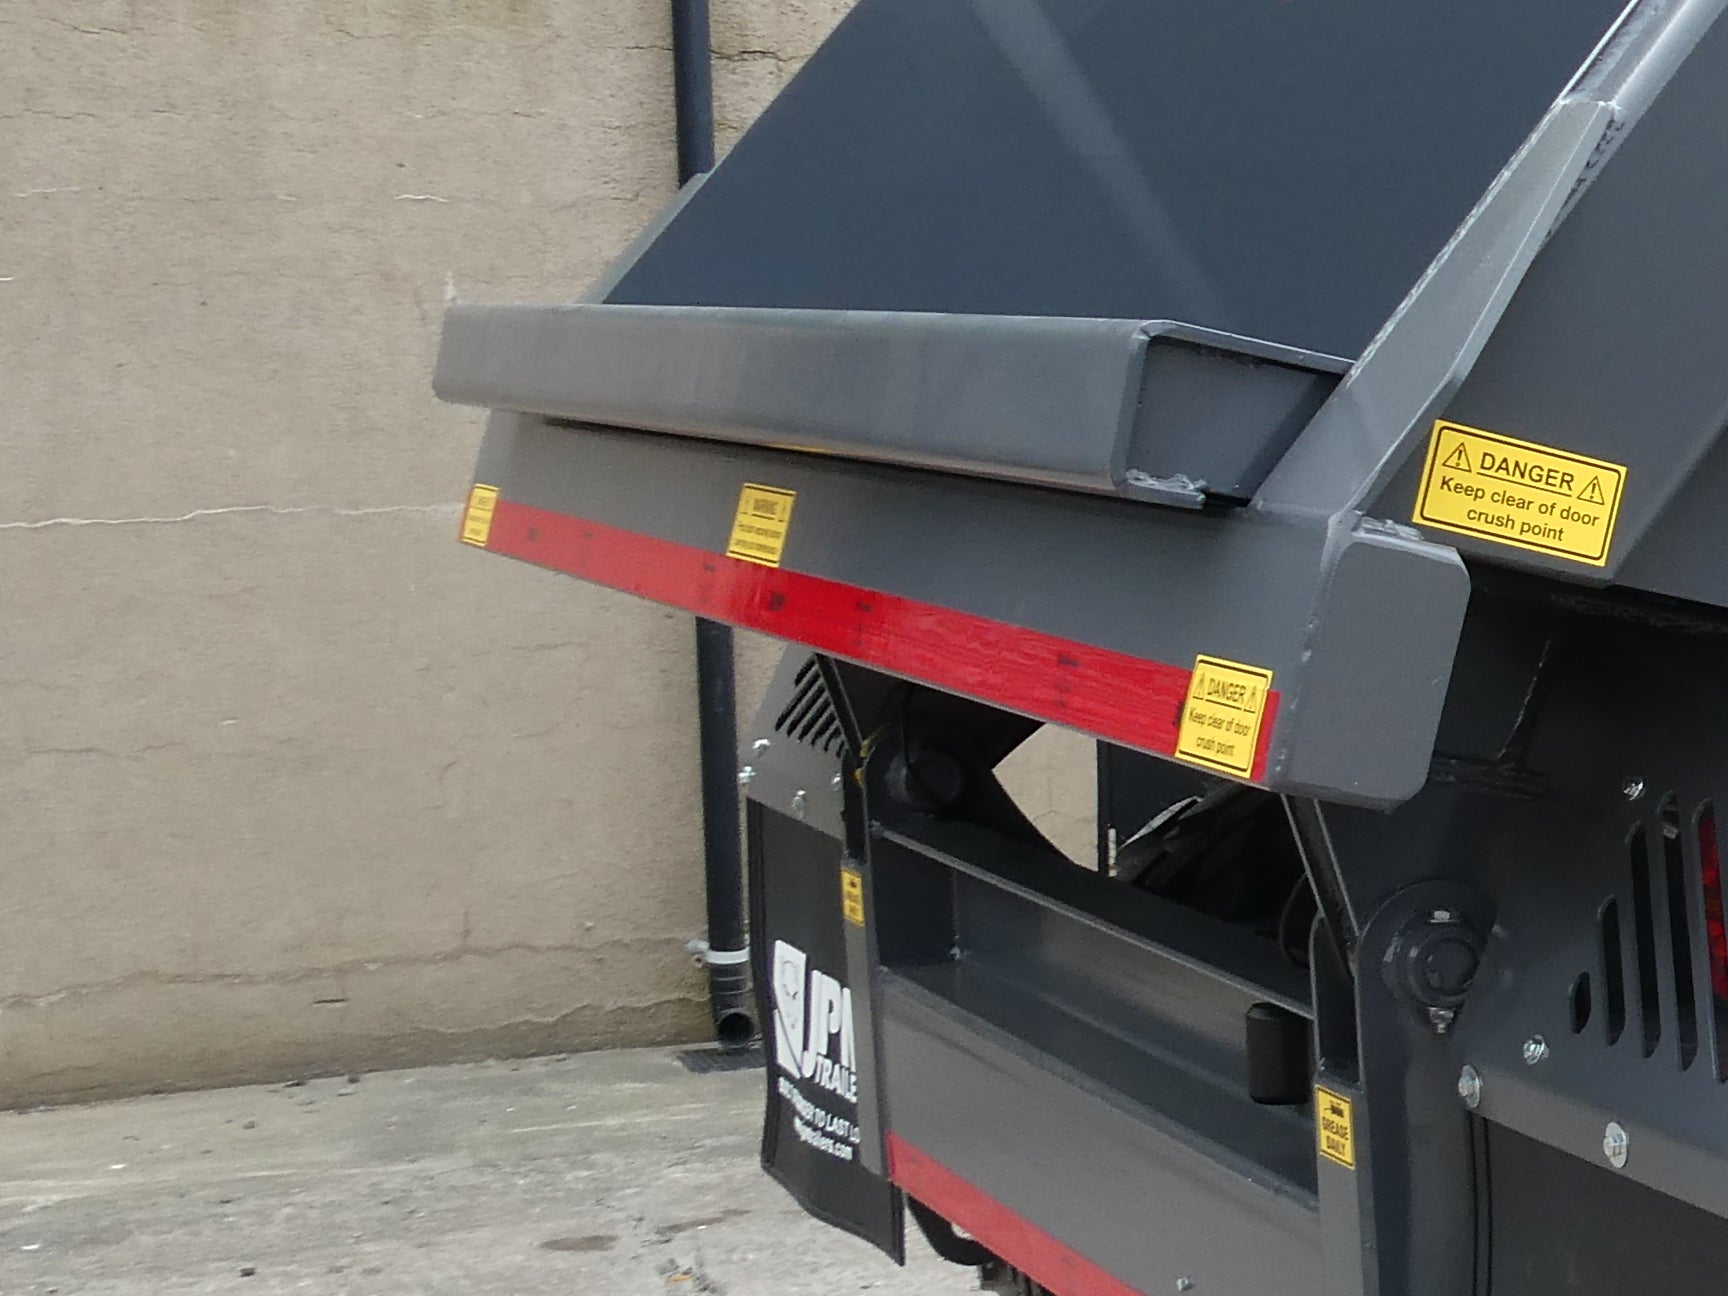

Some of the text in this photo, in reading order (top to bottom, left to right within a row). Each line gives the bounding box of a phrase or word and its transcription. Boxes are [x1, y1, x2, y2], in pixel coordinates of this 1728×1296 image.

[1480, 452, 1575, 491] DANGER
[1440, 476, 1599, 526] Keep clear of door
[1467, 508, 1565, 541] crush point
[1207, 678, 1246, 704] DANGER
[814, 1055, 857, 1103] TRAILE
